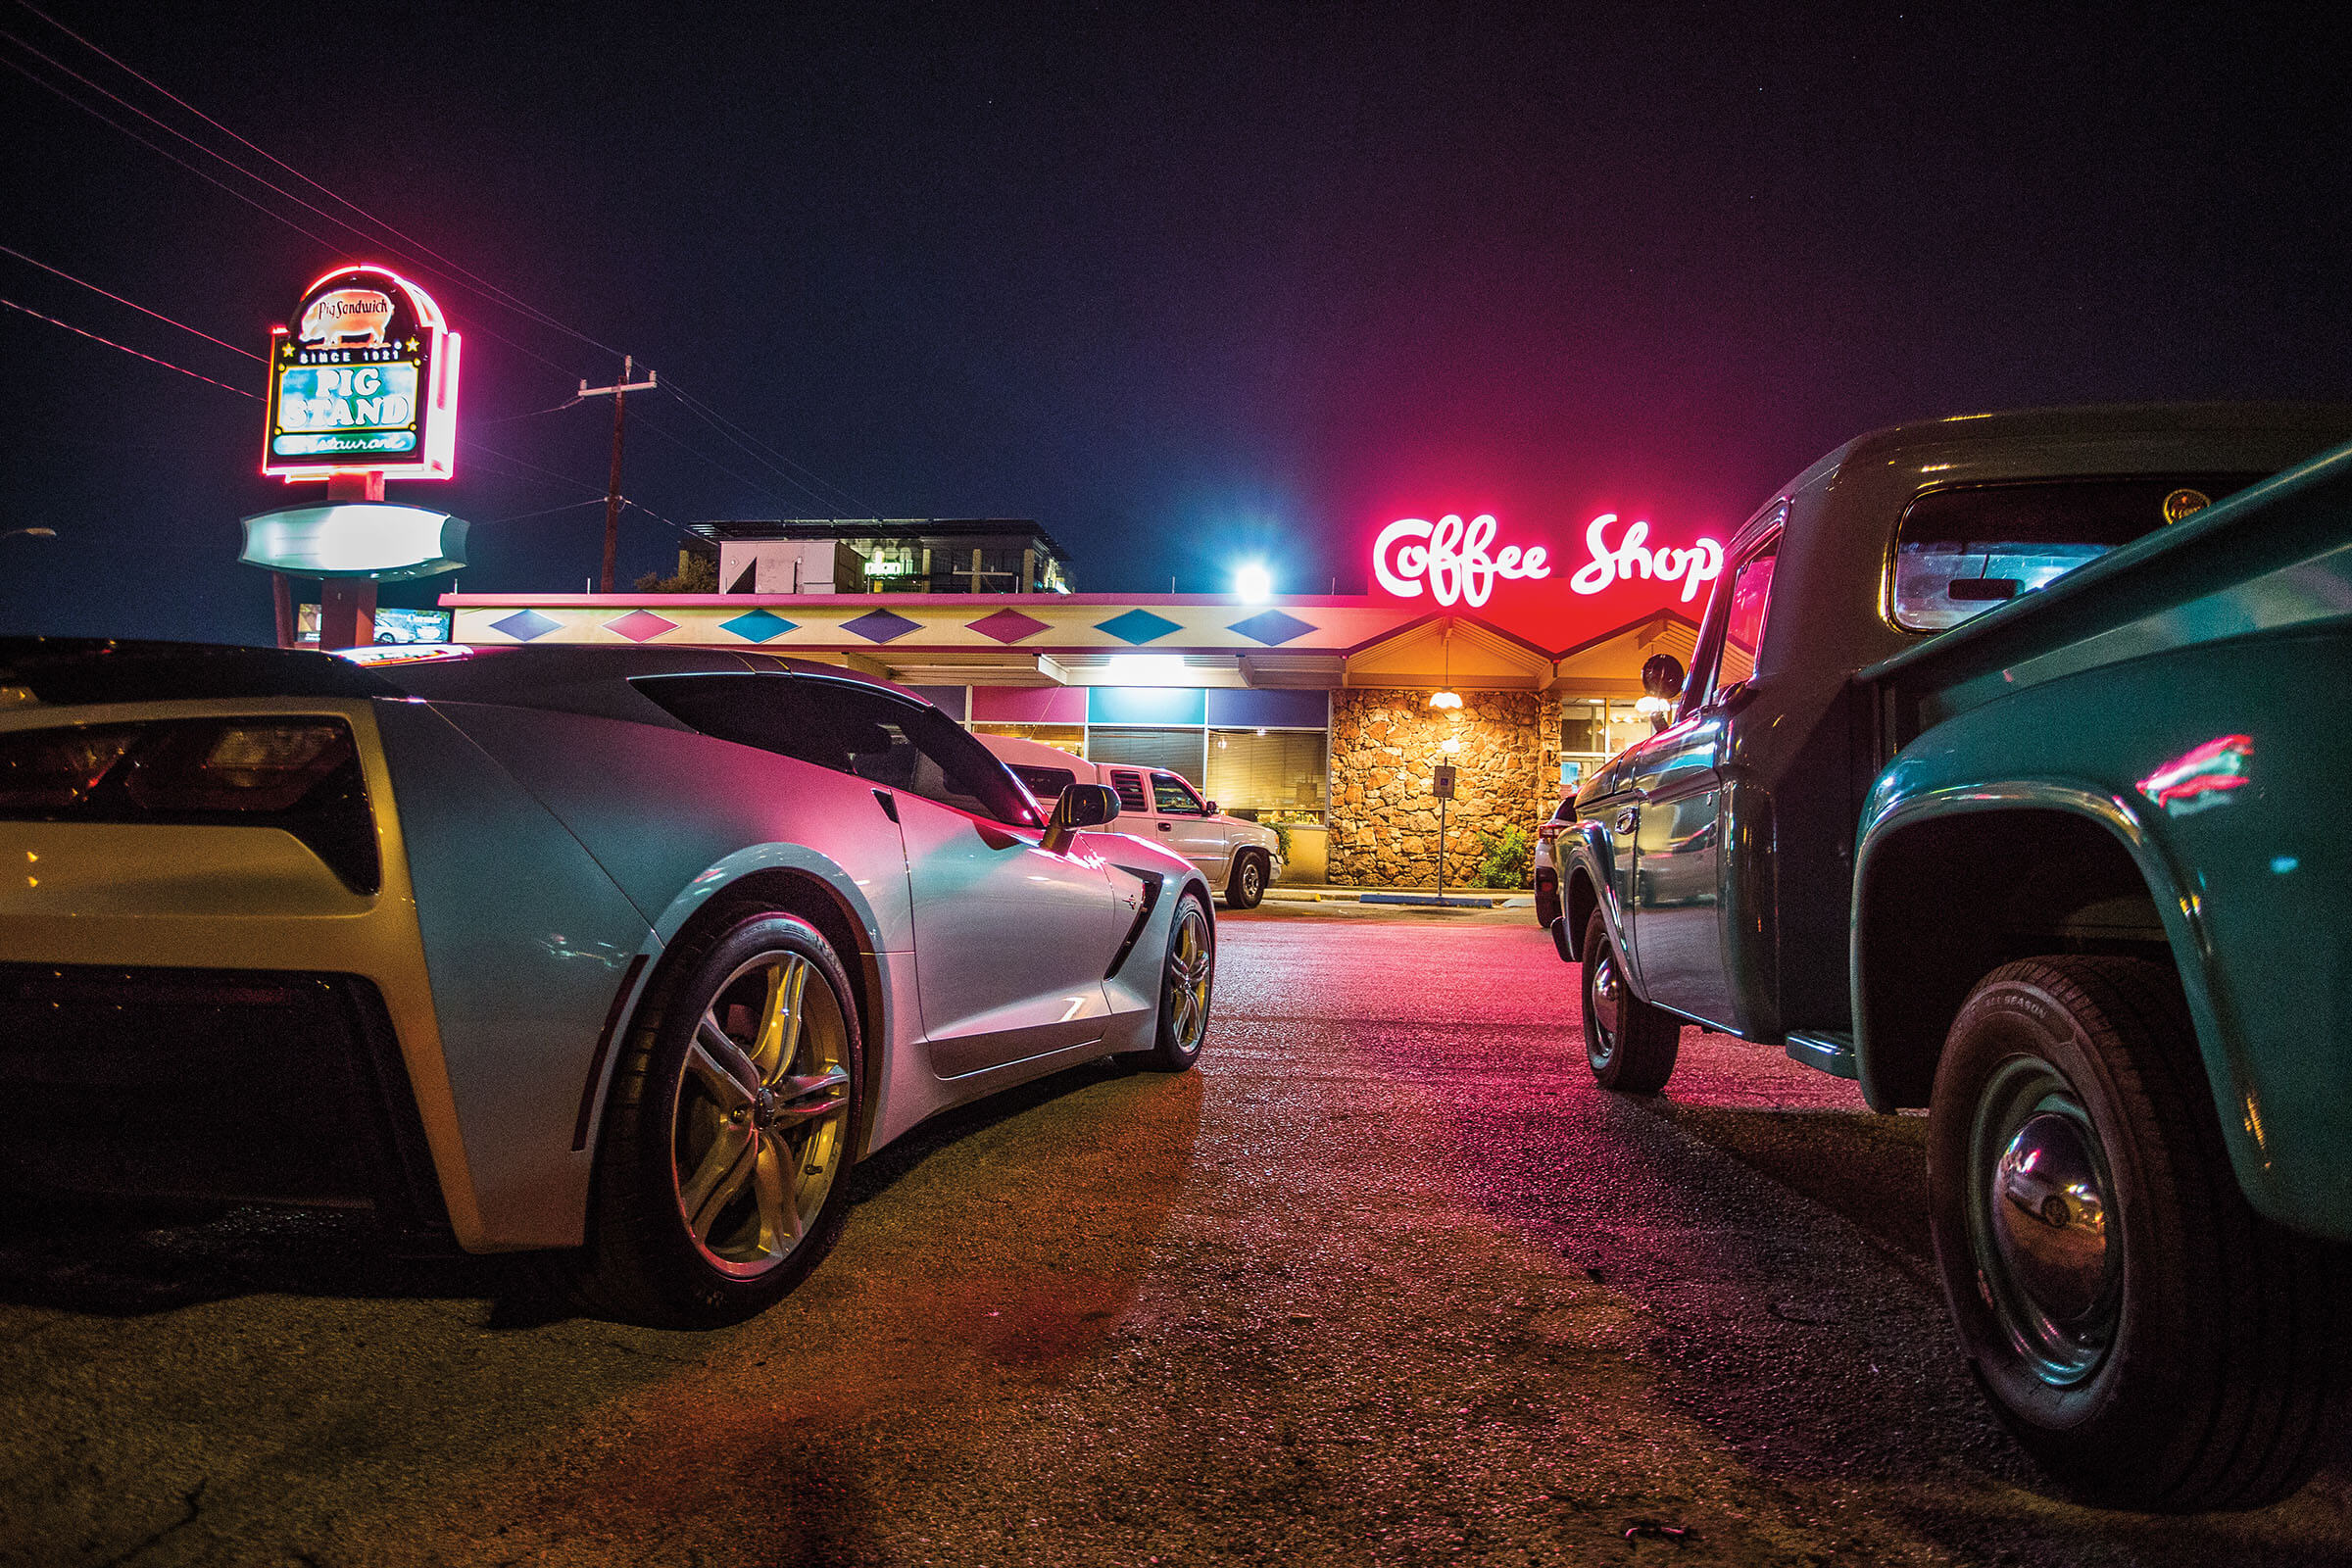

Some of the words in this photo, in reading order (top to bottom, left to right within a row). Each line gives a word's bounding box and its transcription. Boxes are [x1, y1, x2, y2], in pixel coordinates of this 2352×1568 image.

[318, 301, 336, 319] Pig
[336, 299, 388, 318] Sandwich
[299, 351, 351, 365] SINCE
[315, 368, 382, 397] PIG
[285, 394, 409, 427] STAND
[291, 434, 407, 454] staurant
[1372, 514, 1551, 608] Coffee
[1570, 514, 1725, 603] Shop
[2004, 995, 2046, 1018] SEASON
